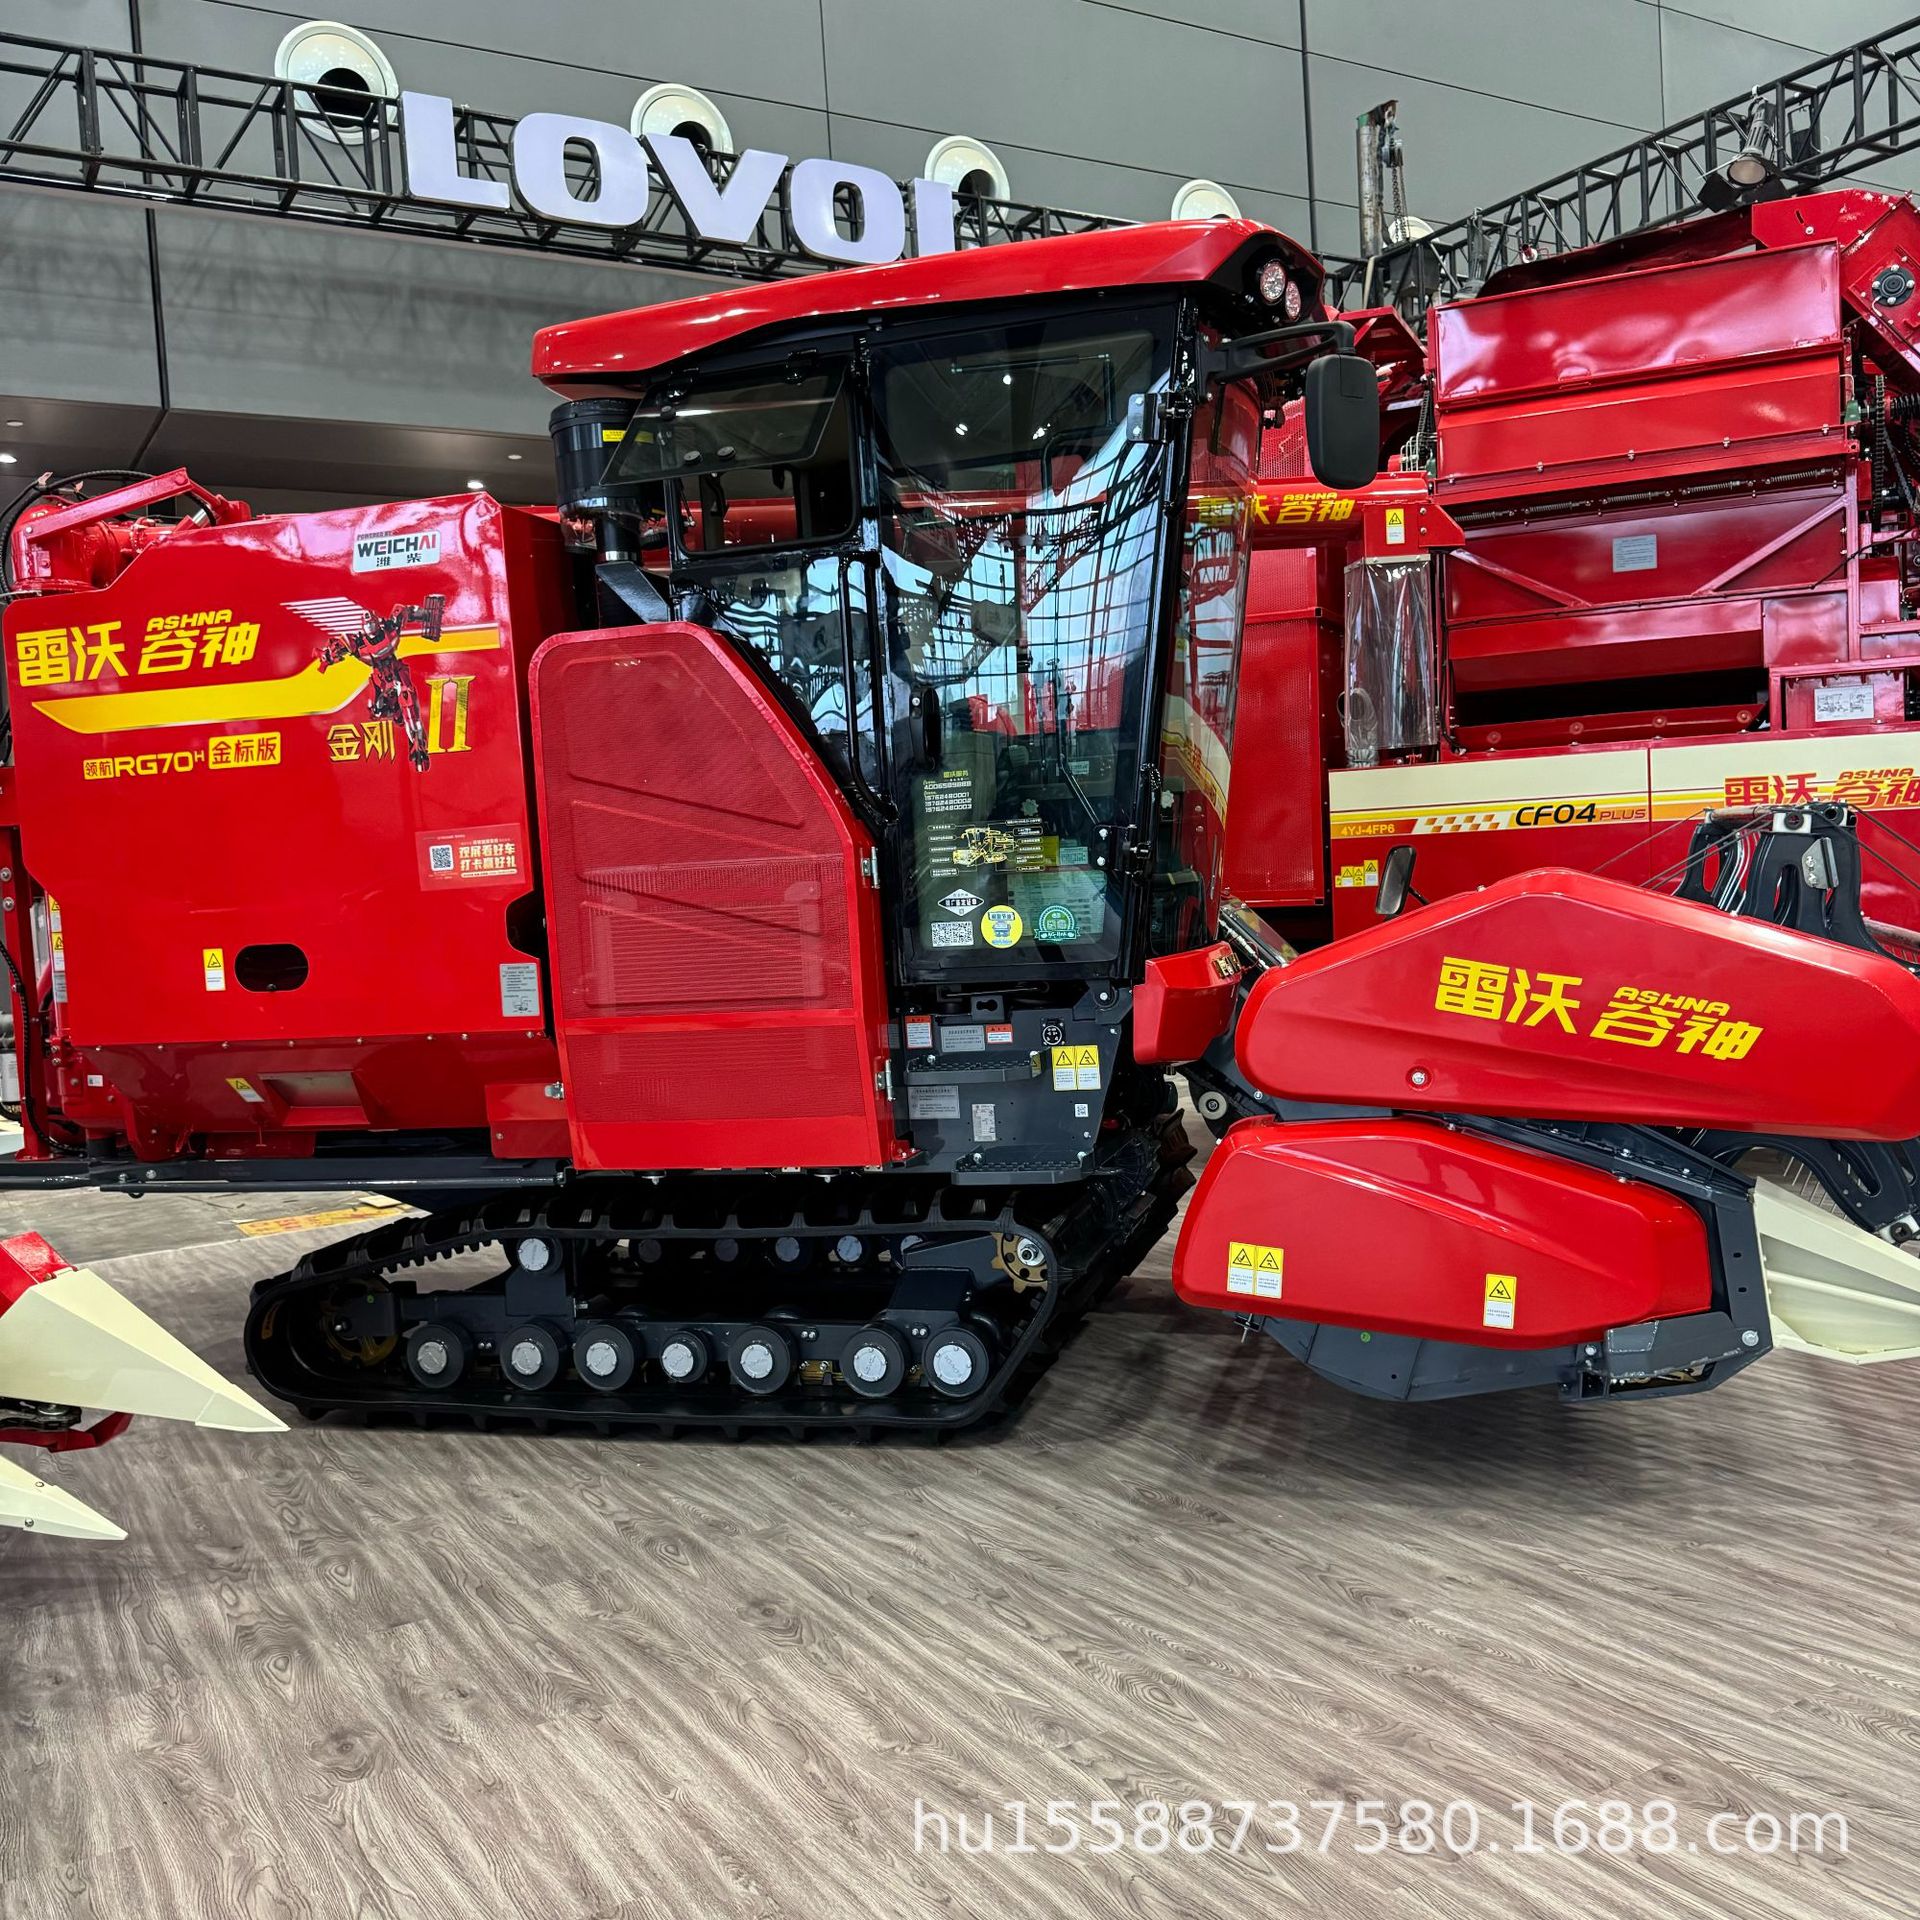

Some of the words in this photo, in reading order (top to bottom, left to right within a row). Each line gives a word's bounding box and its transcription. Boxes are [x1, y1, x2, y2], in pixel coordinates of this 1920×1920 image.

[1276, 499, 1355, 524] 谷神
[1284, 492, 1338, 501] ASHNA
[357, 534, 437, 558] WEICHAI
[147, 609, 232, 632] ASHNA
[16, 620, 129, 687] 雷沃
[138, 622, 261, 675] 谷神
[327, 719, 396, 762] 金刚
[85, 760, 114, 777] 领航
[212, 735, 278, 766] 金标版
[1839, 767, 1914, 780] ASHNA
[1725, 772, 1818, 806] 雷沃
[1832, 777, 1920, 807] 谷神
[1340, 824, 1396, 837] 4YJ-4FP6
[1599, 808, 1646, 820] PLUS
[1435, 956, 1583, 1035] 雷沃
[1589, 1001, 1764, 1061] 谷神
[1613, 986, 1731, 1017] ASHNA
